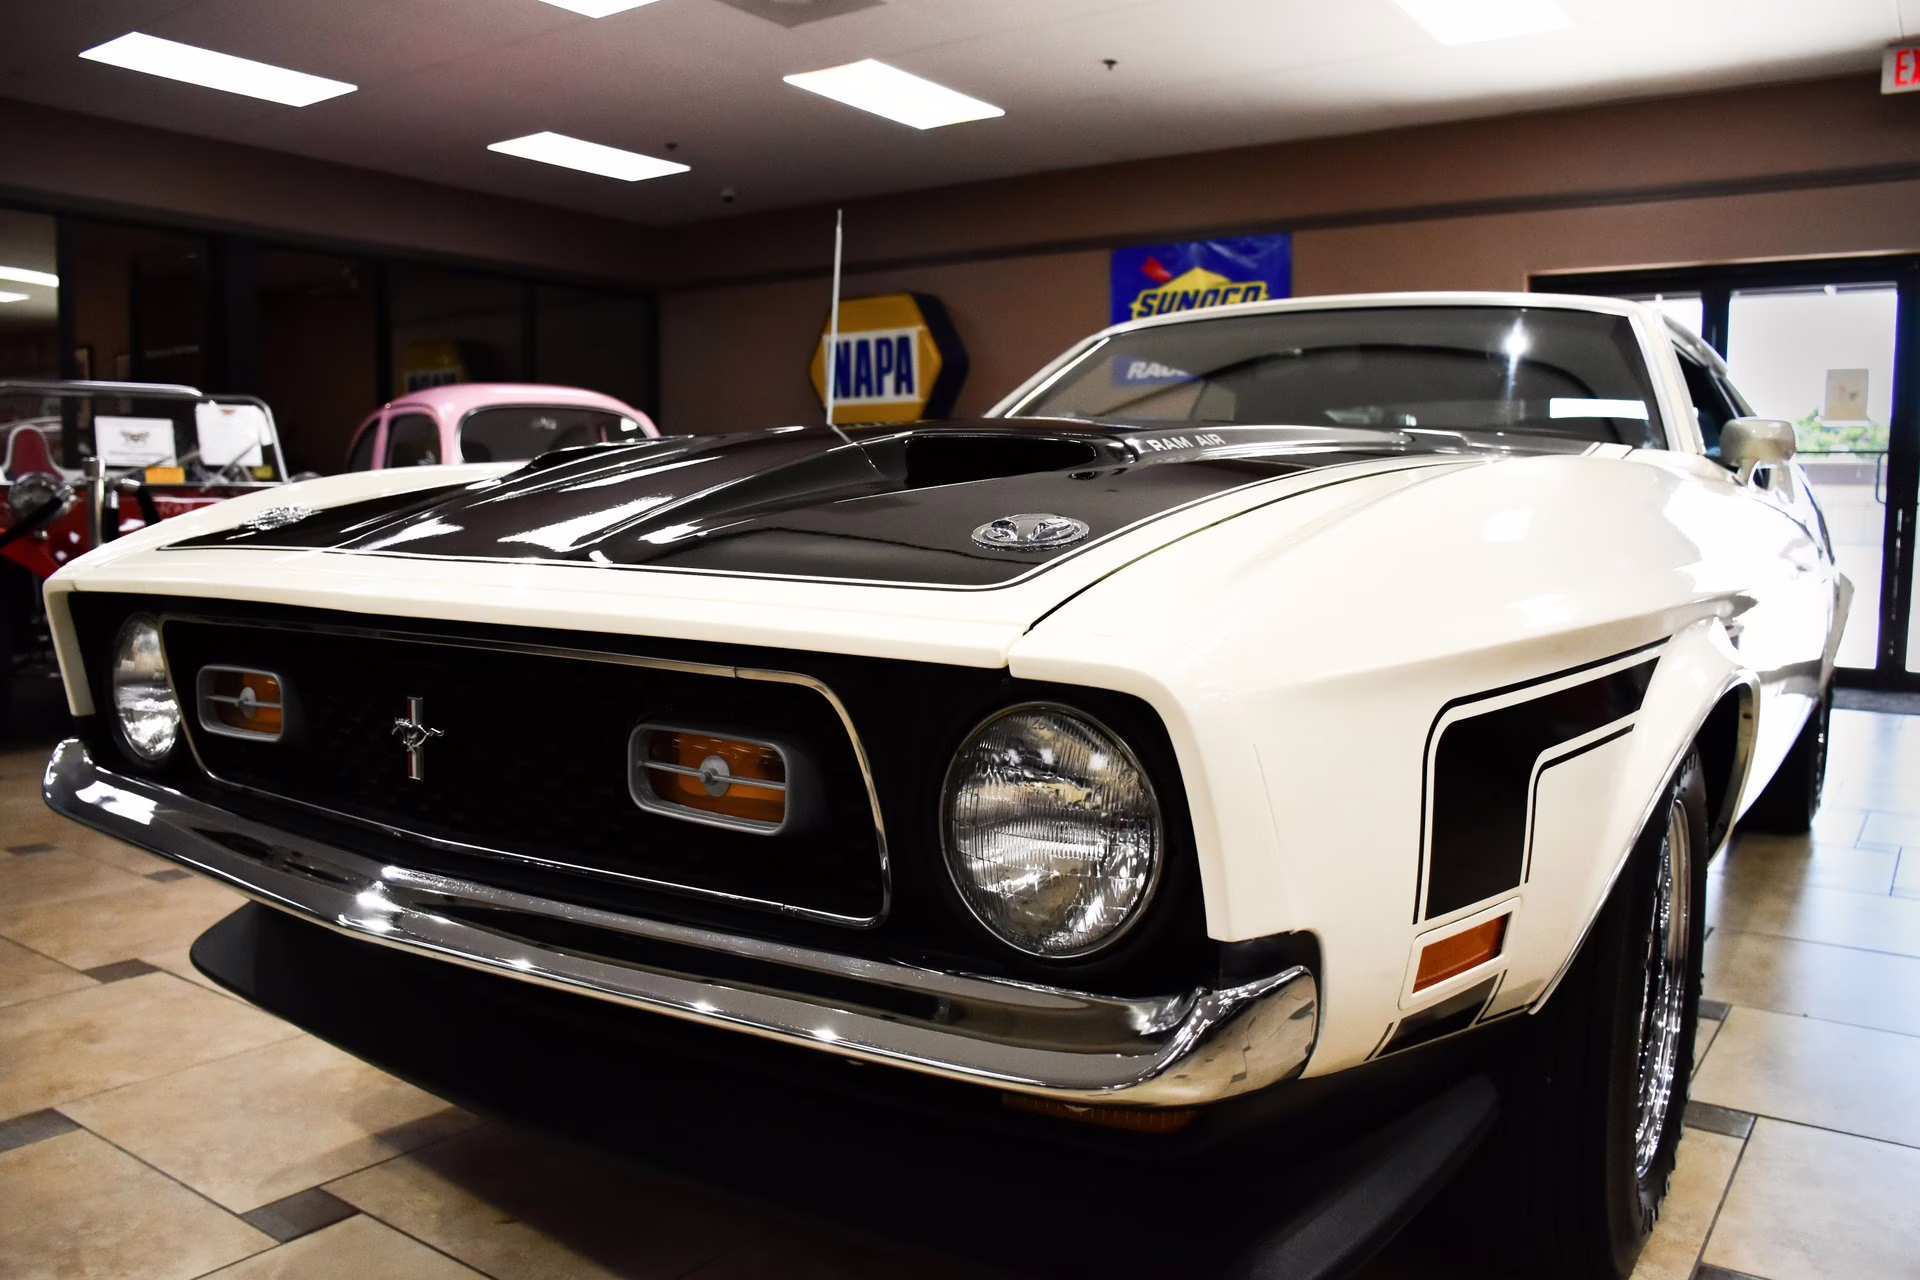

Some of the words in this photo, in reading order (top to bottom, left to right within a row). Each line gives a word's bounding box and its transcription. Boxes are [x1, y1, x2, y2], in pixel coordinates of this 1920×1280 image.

[829, 335, 915, 399] NAPA
[1146, 436, 1194, 452] RAM
[1194, 433, 1226, 447] AIR
